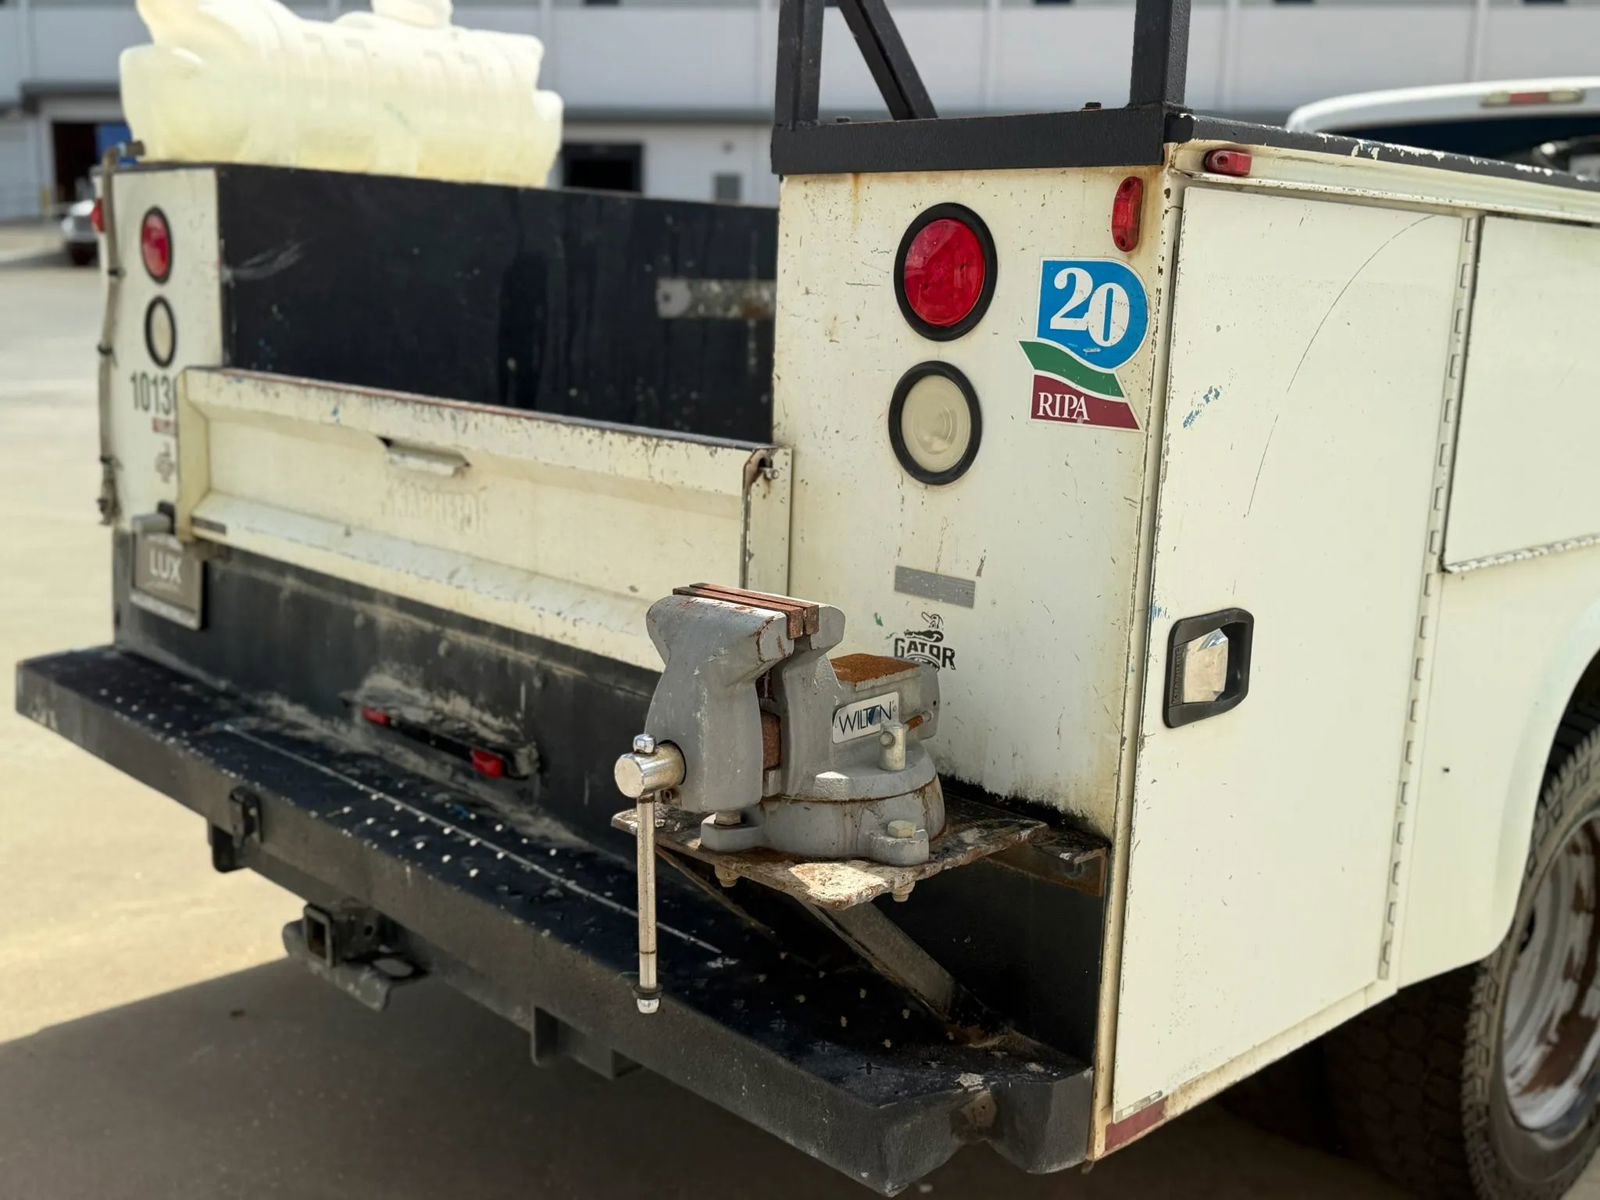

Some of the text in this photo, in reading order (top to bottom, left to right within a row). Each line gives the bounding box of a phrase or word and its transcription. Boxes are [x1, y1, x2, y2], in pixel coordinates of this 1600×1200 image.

[1050, 267, 1130, 347] 20
[1037, 392, 1091, 421] RIPA
[894, 637, 956, 671] GATOR
